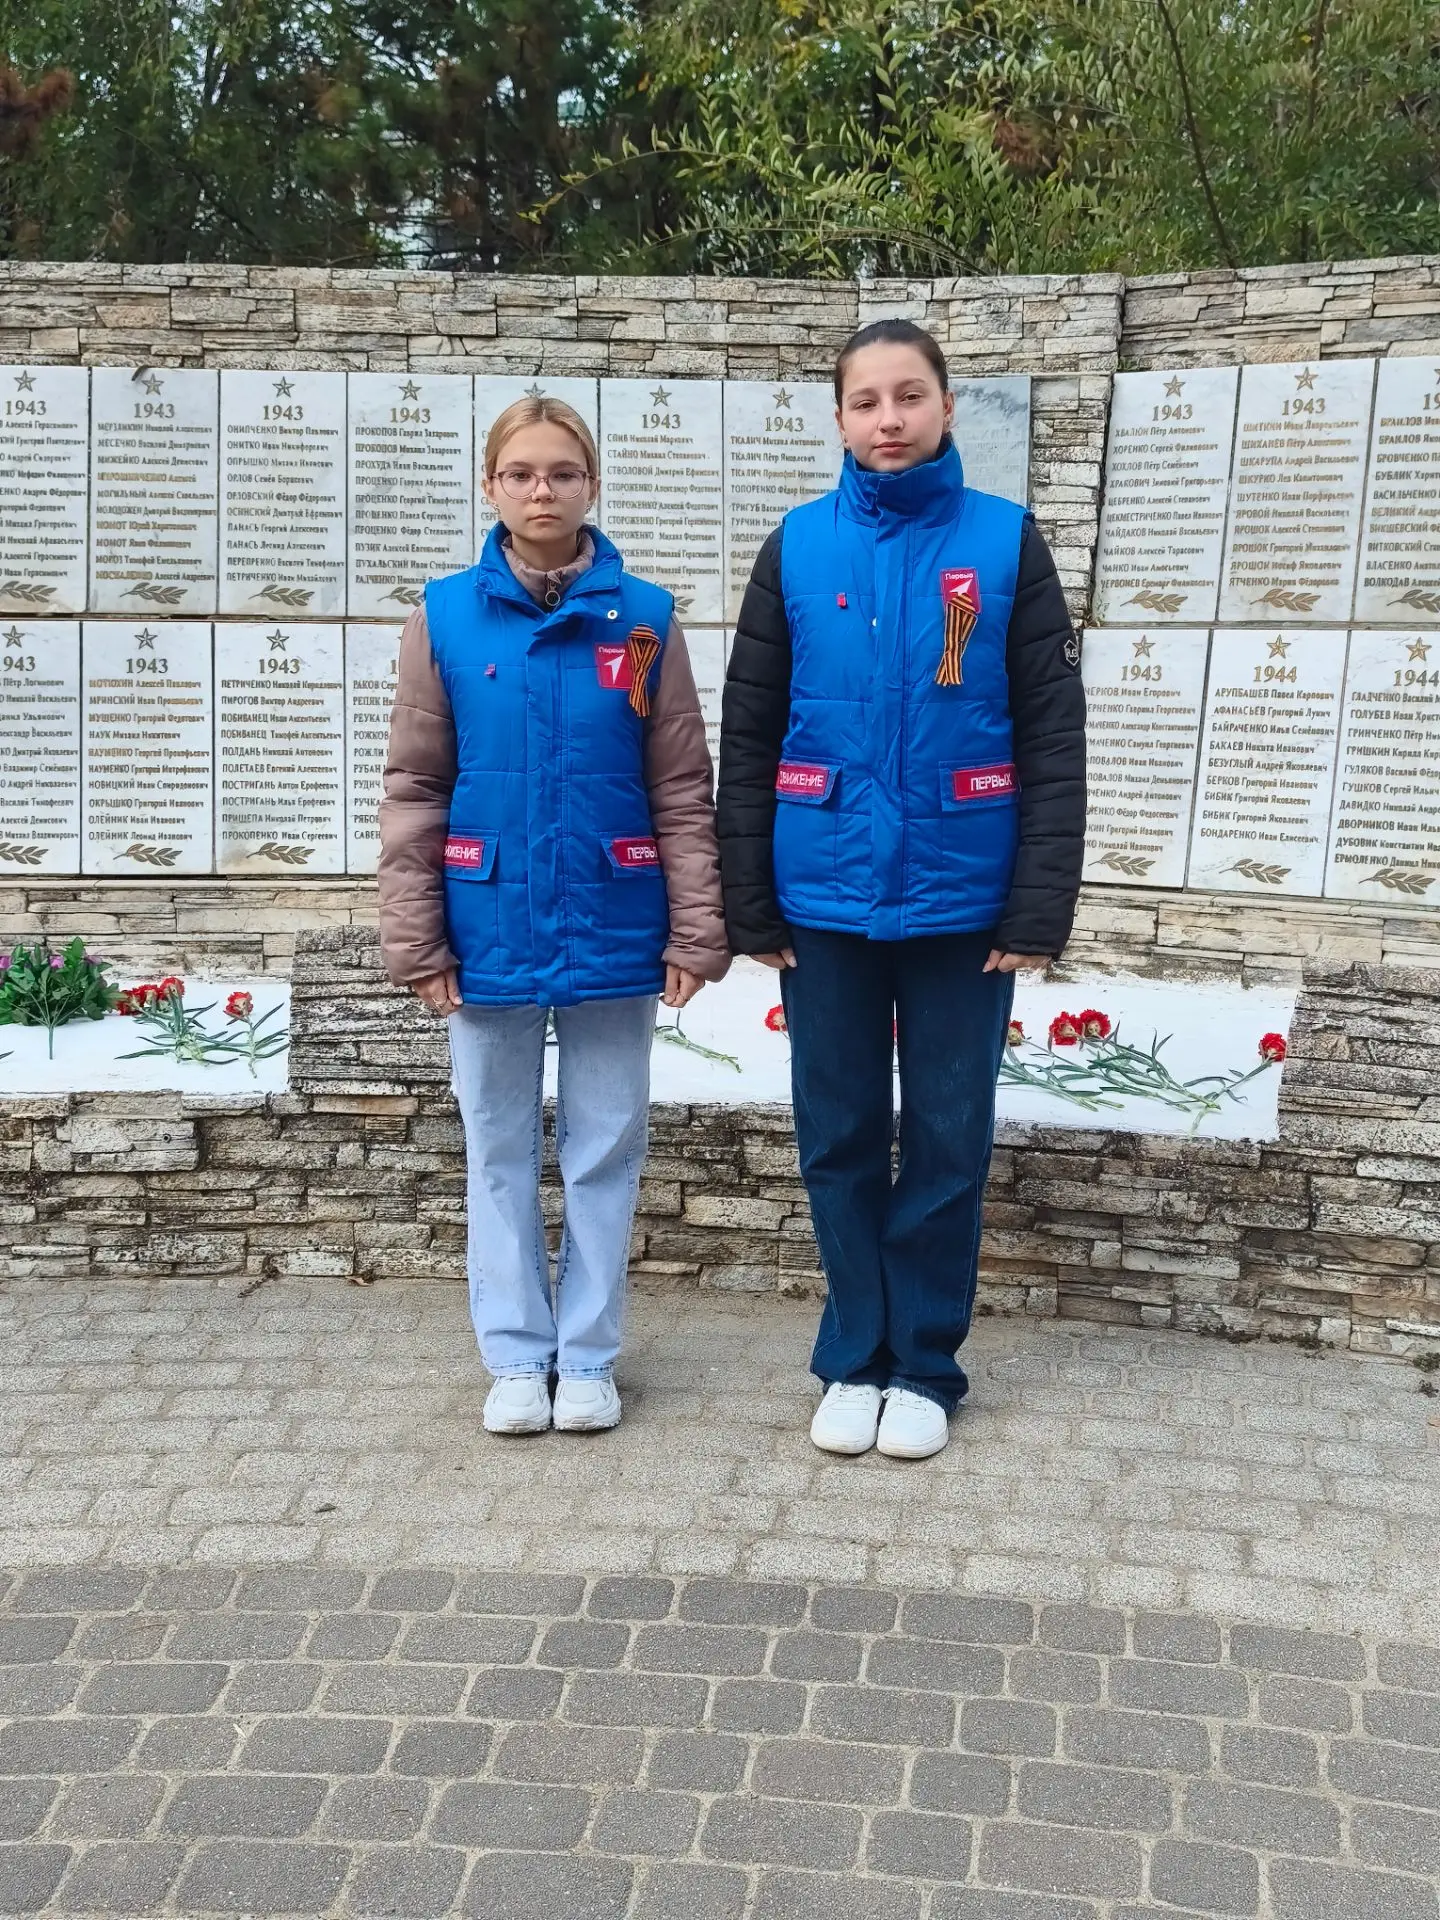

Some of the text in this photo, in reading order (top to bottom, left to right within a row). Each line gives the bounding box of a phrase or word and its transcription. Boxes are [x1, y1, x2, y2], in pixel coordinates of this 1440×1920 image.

[5, 400, 47, 416] 1943
[133, 402, 176, 419] 1943
[262, 405, 304, 421] 1943
[1152, 403, 1194, 422] 1943
[1281, 397, 1327, 416] 1943
[390, 407, 431, 424] 1943
[641, 413, 682, 430] 1943
[764, 416, 805, 433] 1943
[0, 656, 36, 673] 943
[126, 657, 169, 674] 1943
[258, 658, 301, 675] 1943
[1121, 664, 1163, 682] 1943
[1253, 665, 1298, 684] 1944
[1393, 668, 1440, 688] 1944
[970, 773, 1013, 792] ПЕРВЫХ
[627, 843, 659, 861] ПЕРВЫ
